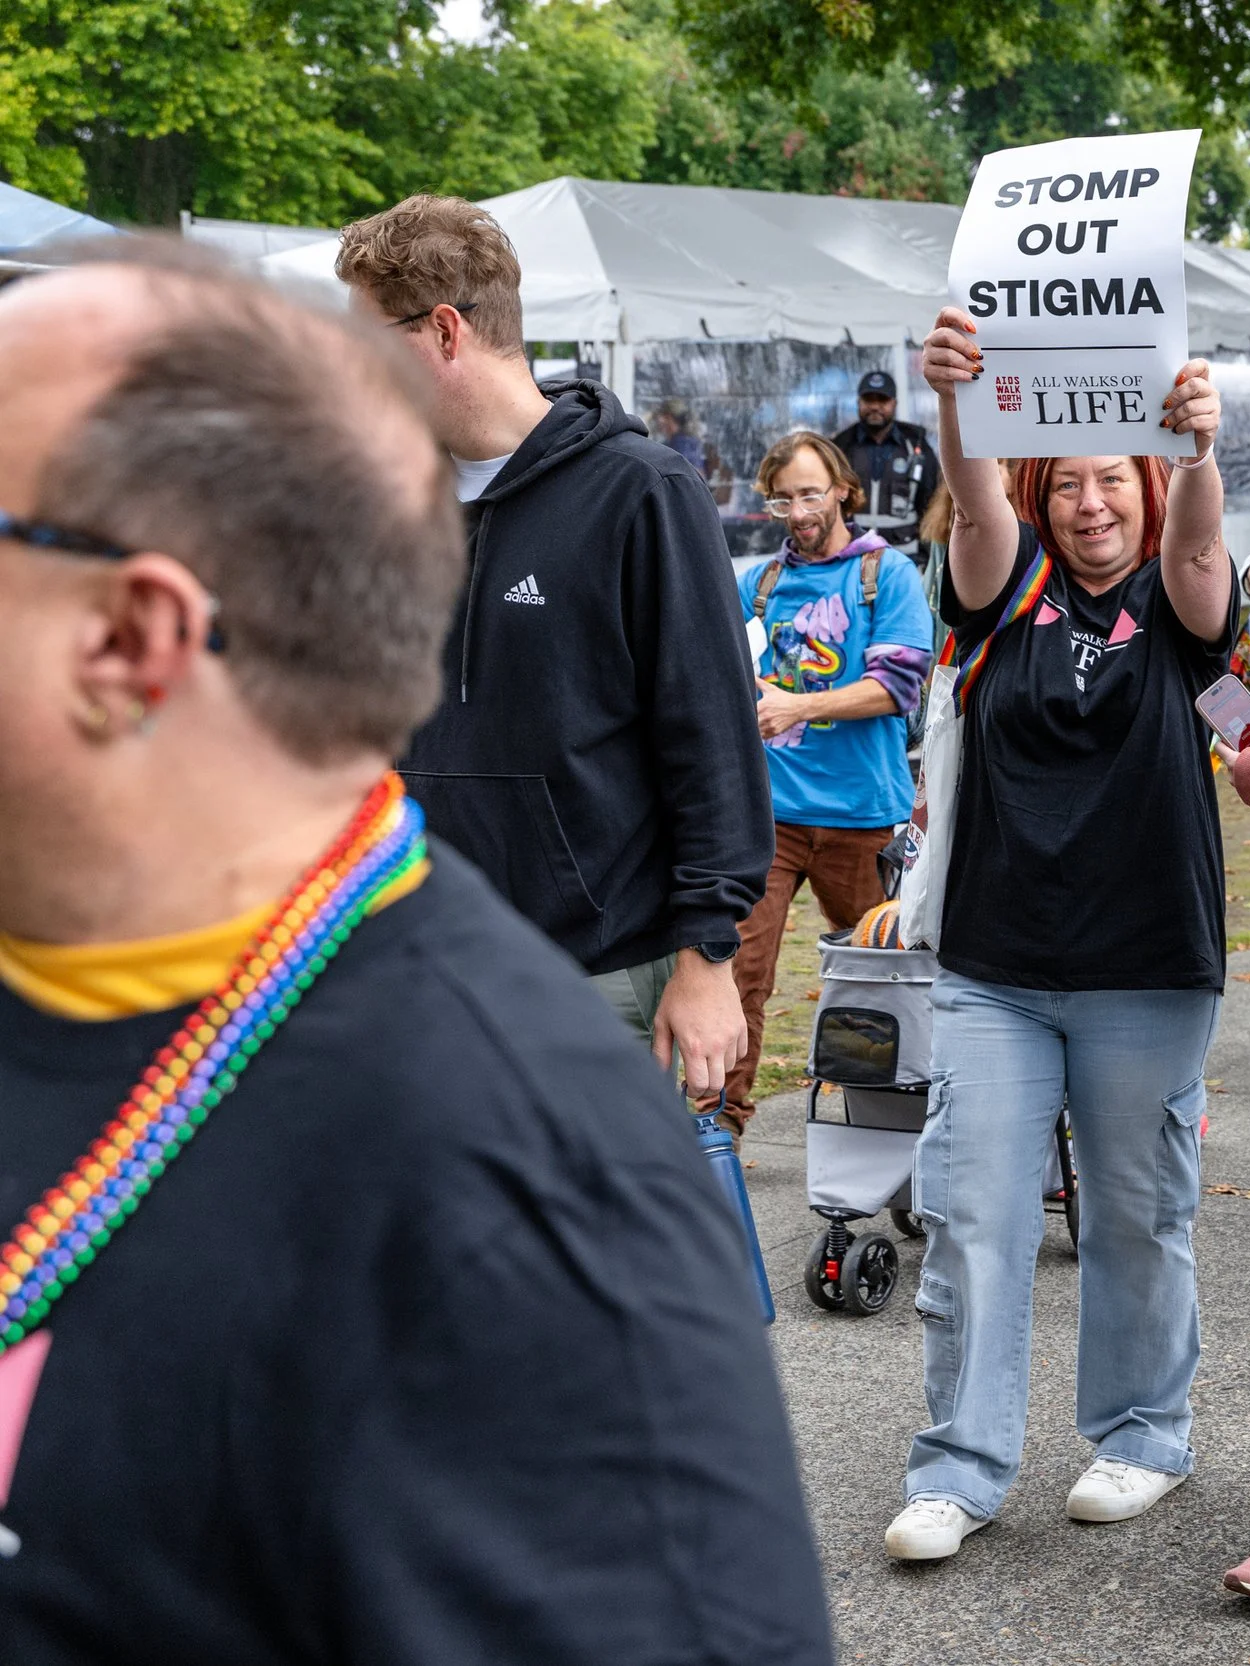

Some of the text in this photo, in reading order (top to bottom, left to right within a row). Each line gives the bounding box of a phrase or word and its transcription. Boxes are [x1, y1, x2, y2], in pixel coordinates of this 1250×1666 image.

[994, 167, 1160, 208] STOMP
[1017, 219, 1118, 256] OUT
[968, 277, 1165, 318] STIGMA
[995, 376, 1020, 385] AIDS
[1031, 375, 1143, 388] ALL WALKS OF
[995, 385, 1021, 394] WALK
[996, 394, 1022, 402] NORTH
[997, 402, 1022, 412] WEST
[1032, 390, 1146, 425] LIFE
[504, 591, 546, 605] adidas
